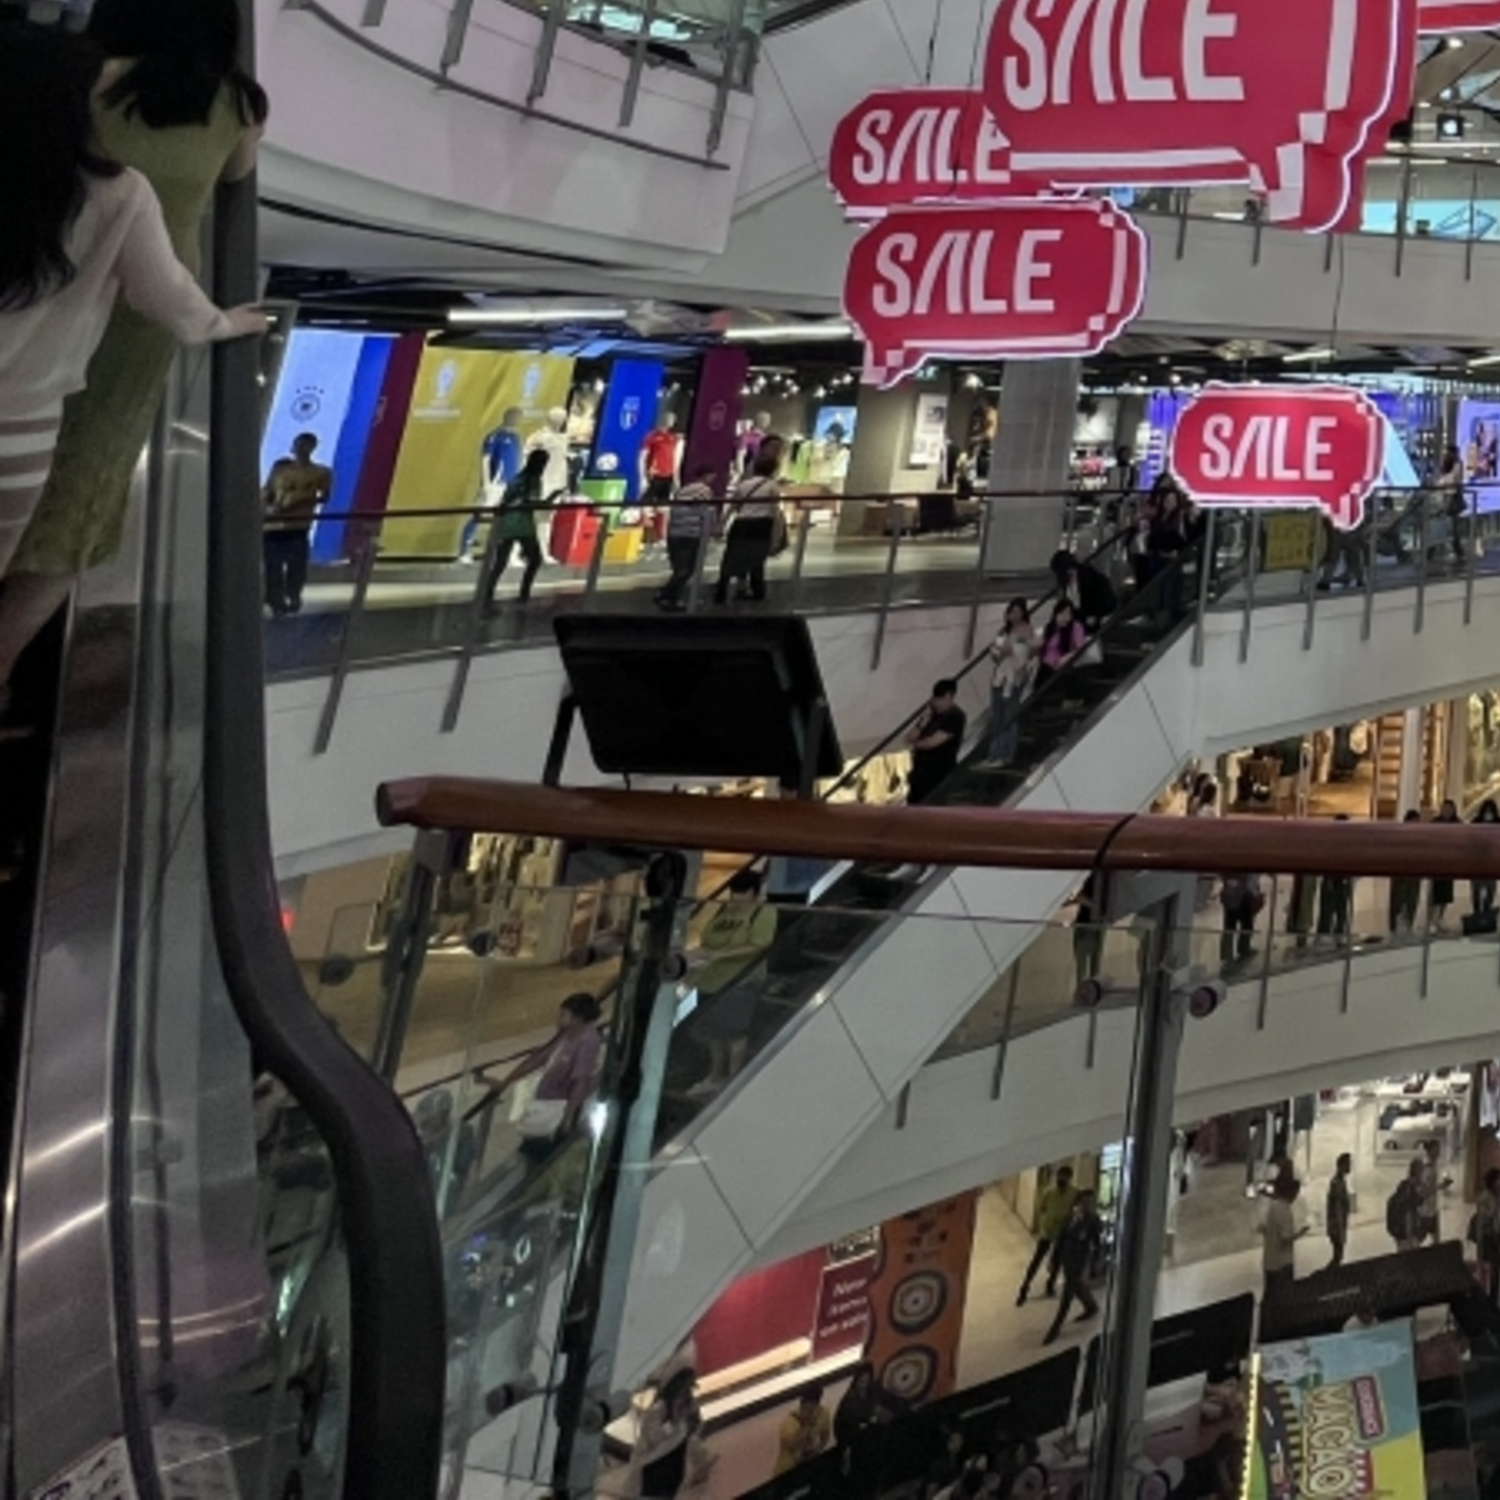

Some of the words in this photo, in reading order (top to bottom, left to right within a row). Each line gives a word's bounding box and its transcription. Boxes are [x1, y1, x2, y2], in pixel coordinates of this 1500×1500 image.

[853, 107, 1011, 185] SALE
[872, 229, 1063, 318] SALE
[1201, 414, 1338, 483] SALE
